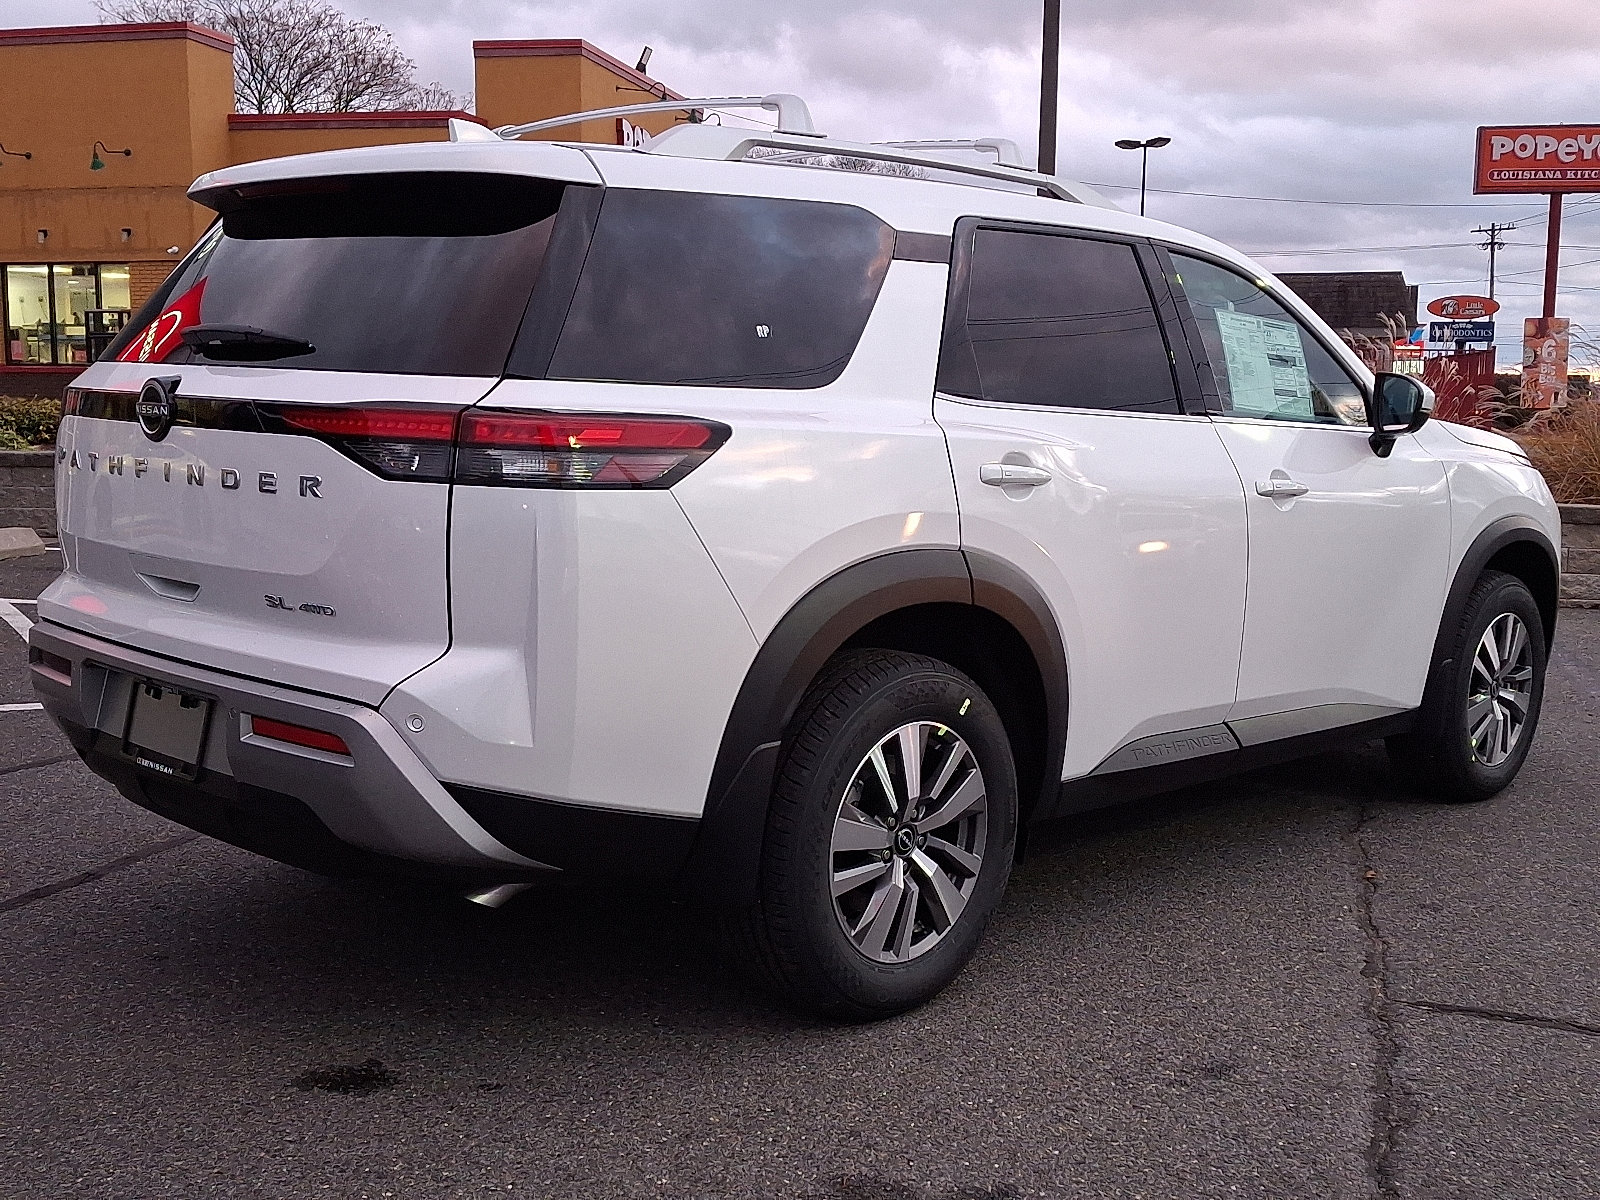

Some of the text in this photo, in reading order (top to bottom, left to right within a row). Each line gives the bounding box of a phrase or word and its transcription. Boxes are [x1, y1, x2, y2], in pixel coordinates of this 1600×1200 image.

[1490, 133, 1600, 163] POPeY
[1493, 170, 1599, 180] LOUISIANA KITC
[1432, 329, 1493, 337] ORODONTICS
[136, 401, 168, 415] NISSAN
[57, 446, 323, 498] PATHFINDER
[264, 594, 336, 617] SL 4WD
[1131, 732, 1232, 760] PATHFINDER
